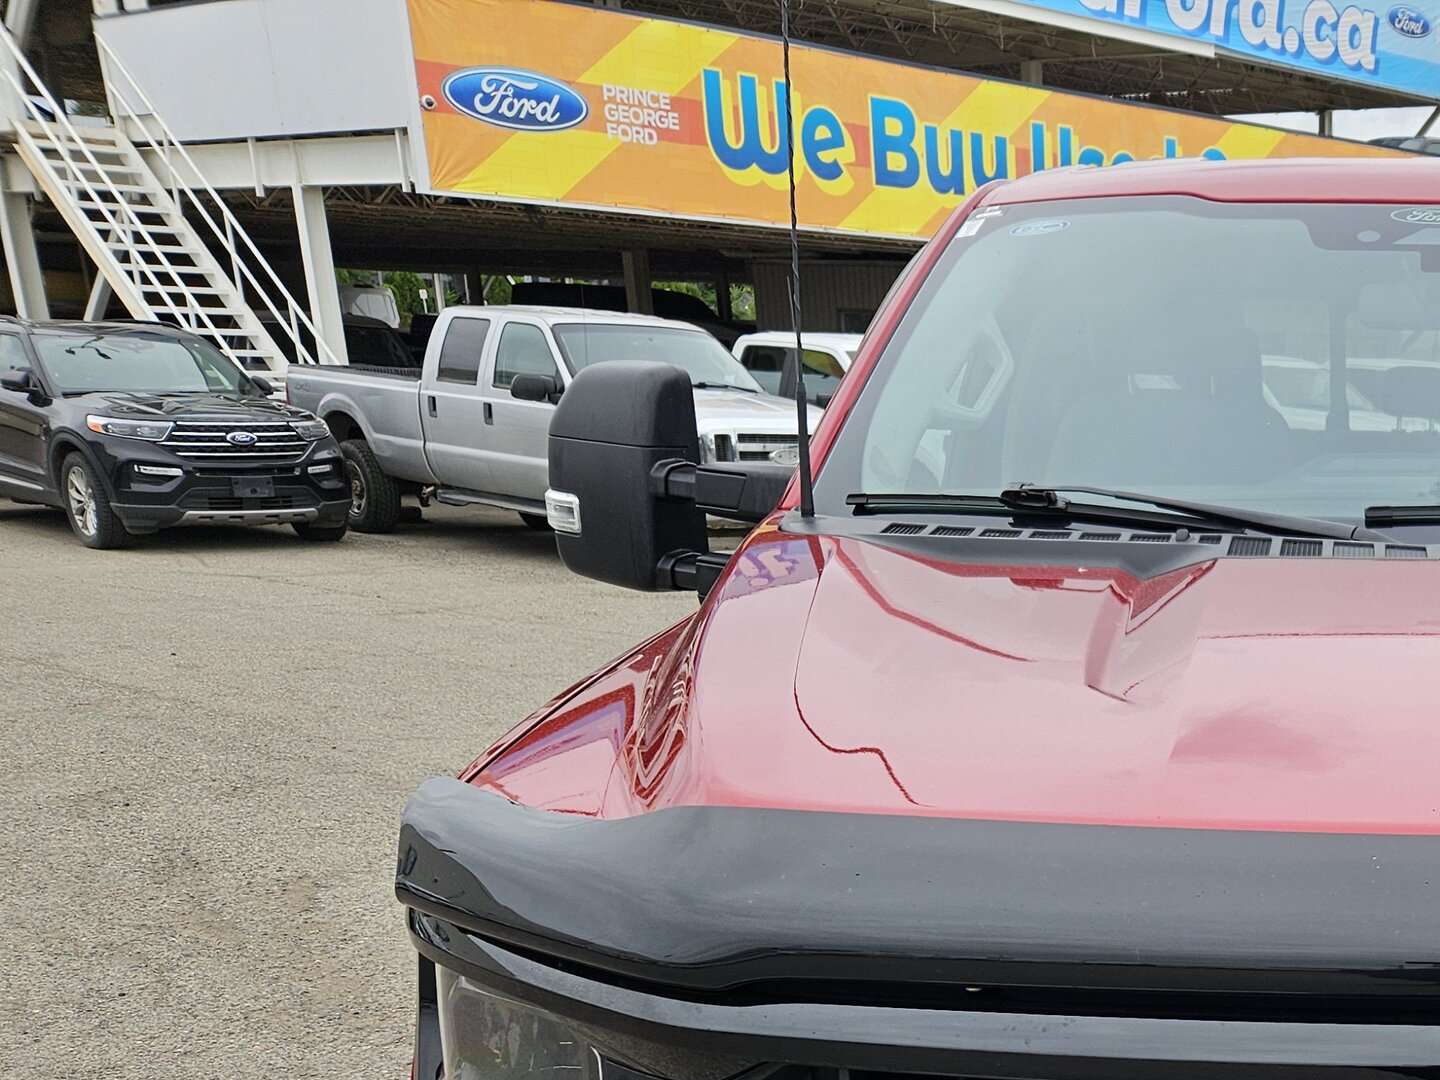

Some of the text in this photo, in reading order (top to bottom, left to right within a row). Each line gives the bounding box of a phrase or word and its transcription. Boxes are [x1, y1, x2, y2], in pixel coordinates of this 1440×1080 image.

[1394, 8, 1425, 34] Ford
[474, 74, 560, 123] Ford
[602, 84, 671, 110] PRINCE
[604, 104, 680, 130] GEORGE
[702, 68, 845, 181] We
[607, 124, 658, 145] FORD
